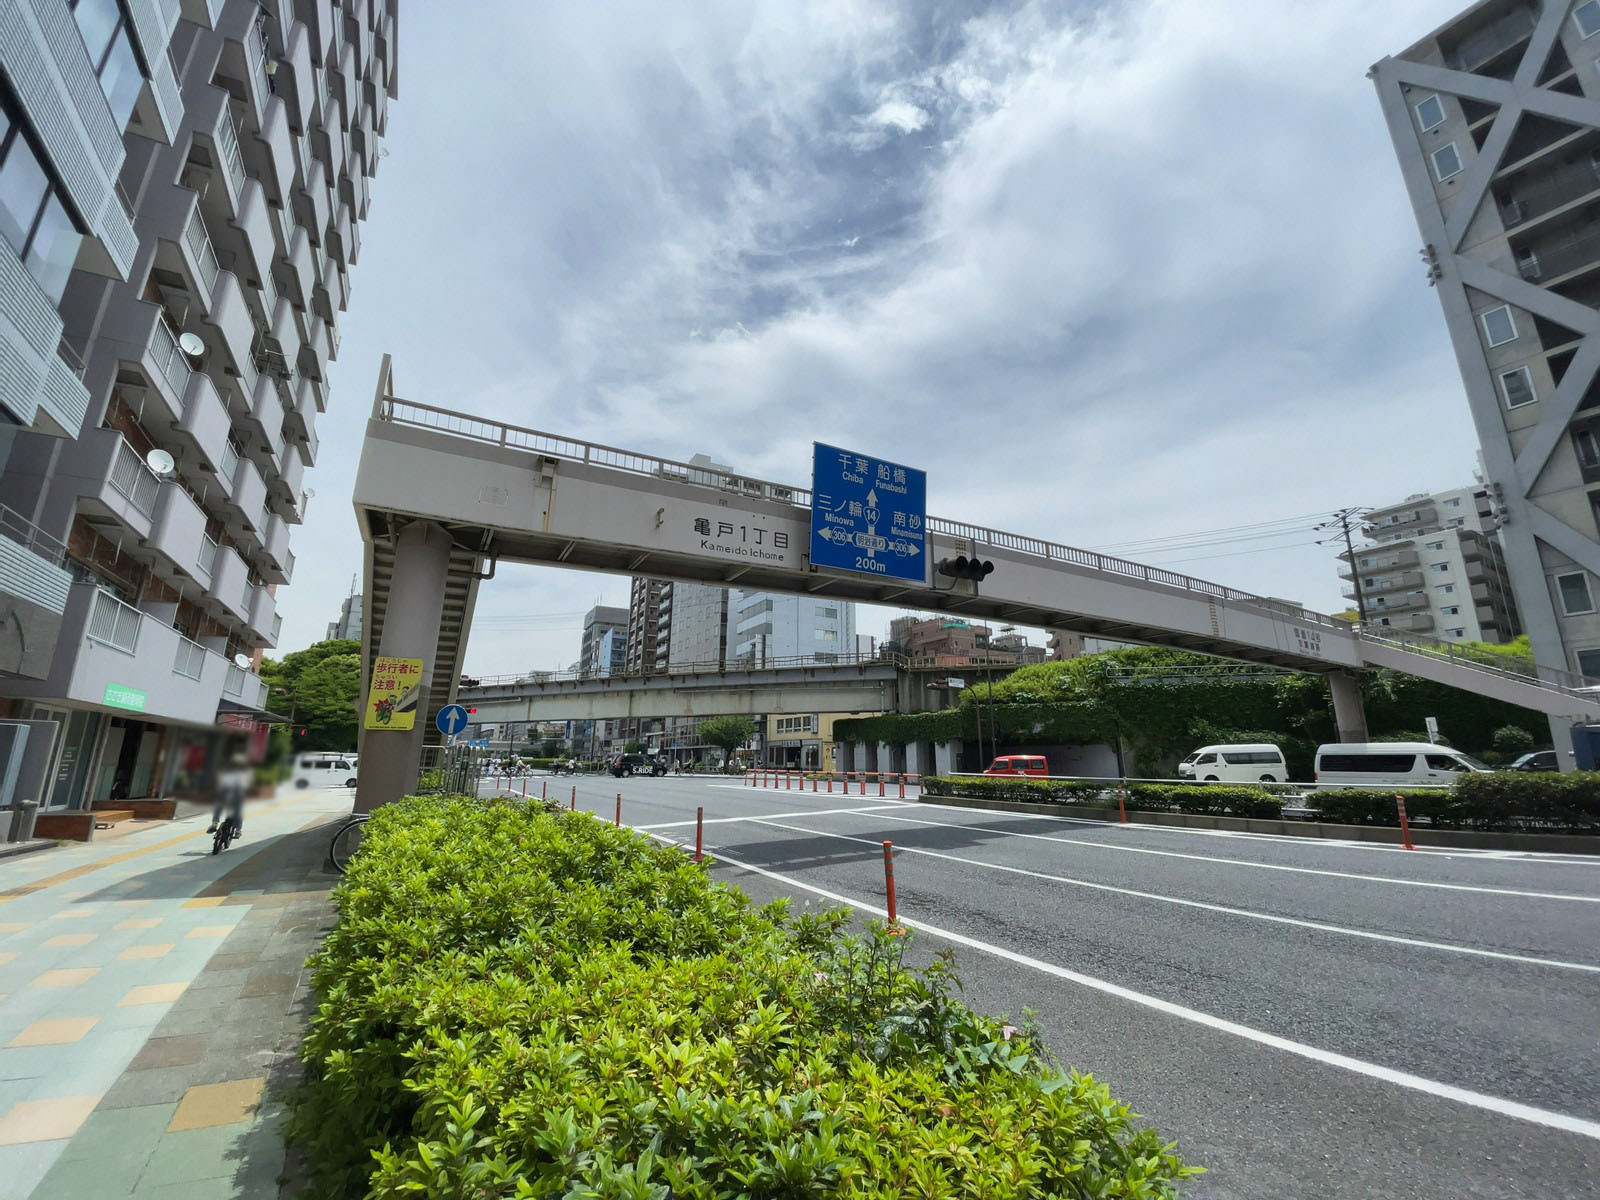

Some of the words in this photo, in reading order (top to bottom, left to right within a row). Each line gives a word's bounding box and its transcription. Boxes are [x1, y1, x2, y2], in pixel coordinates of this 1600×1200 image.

[838, 453, 869, 475] 千葉
[878, 463, 906, 485] 船橋
[842, 471, 864, 485] Chiba
[875, 479, 907, 494] Funabashi
[818, 493, 863, 518] 三ノ輪
[824, 512, 855, 527] Minowa
[866, 509, 876, 522] 14
[893, 511, 922, 530] 南砂
[694, 517, 788, 549] 亀戸1丁目
[832, 530, 846, 541] 306
[700, 539, 748, 556] Kameido
[750, 547, 784, 561] Ichome
[855, 534, 885, 550] 明治通り
[895, 542, 908, 553] 306
[855, 556, 886, 573] 200m
[376, 663, 419, 673] 歩行者に
